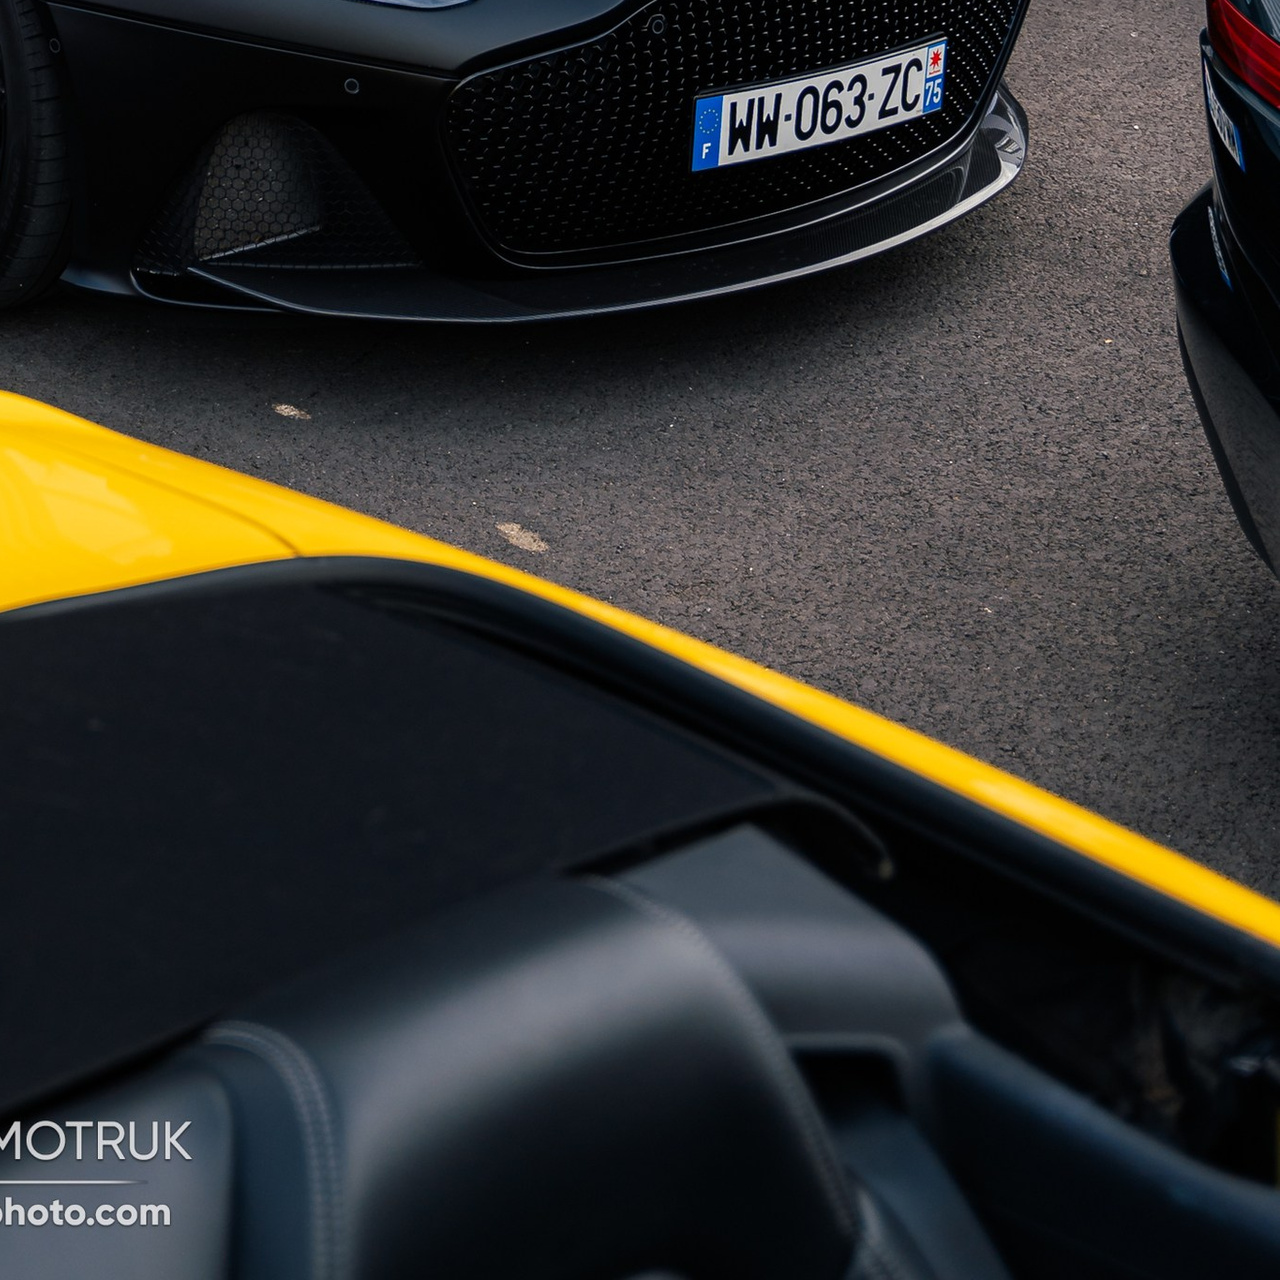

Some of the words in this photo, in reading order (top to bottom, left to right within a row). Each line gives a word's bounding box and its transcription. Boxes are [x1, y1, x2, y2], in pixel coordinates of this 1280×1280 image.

[727, 57, 923, 157] WW-063-ZC
[925, 78, 942, 107] 75
[701, 142, 712, 160] F
